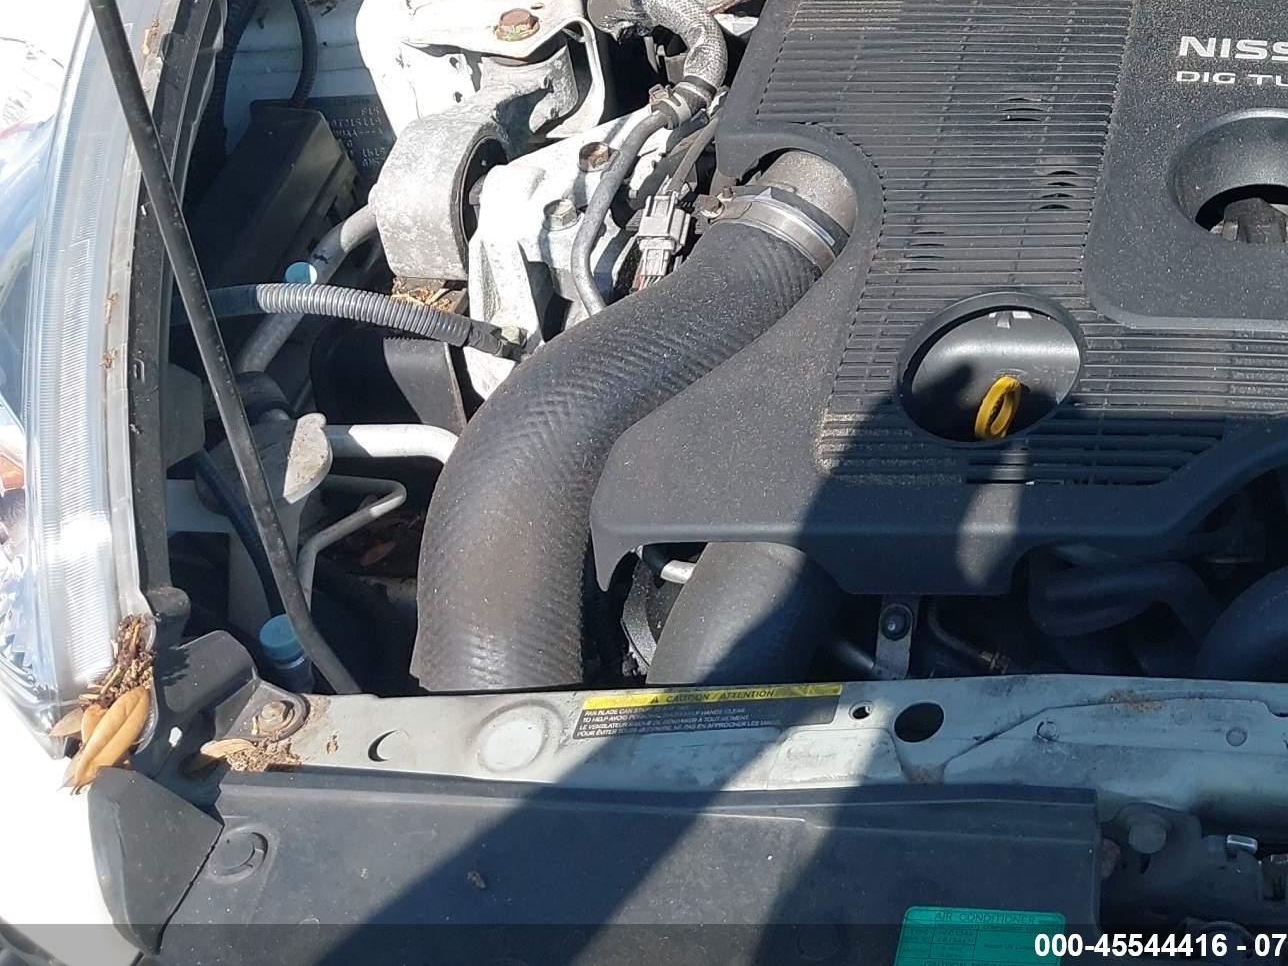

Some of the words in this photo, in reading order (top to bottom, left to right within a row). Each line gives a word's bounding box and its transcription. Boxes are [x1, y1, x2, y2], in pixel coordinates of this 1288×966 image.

[1176, 70, 1236, 84] DIG
[666, 693, 710, 703] CAUTION
[720, 689, 775, 699] ATTENTION
[935, 912, 953, 922] AIR
[959, 913, 1036, 924] CONDITIONER
